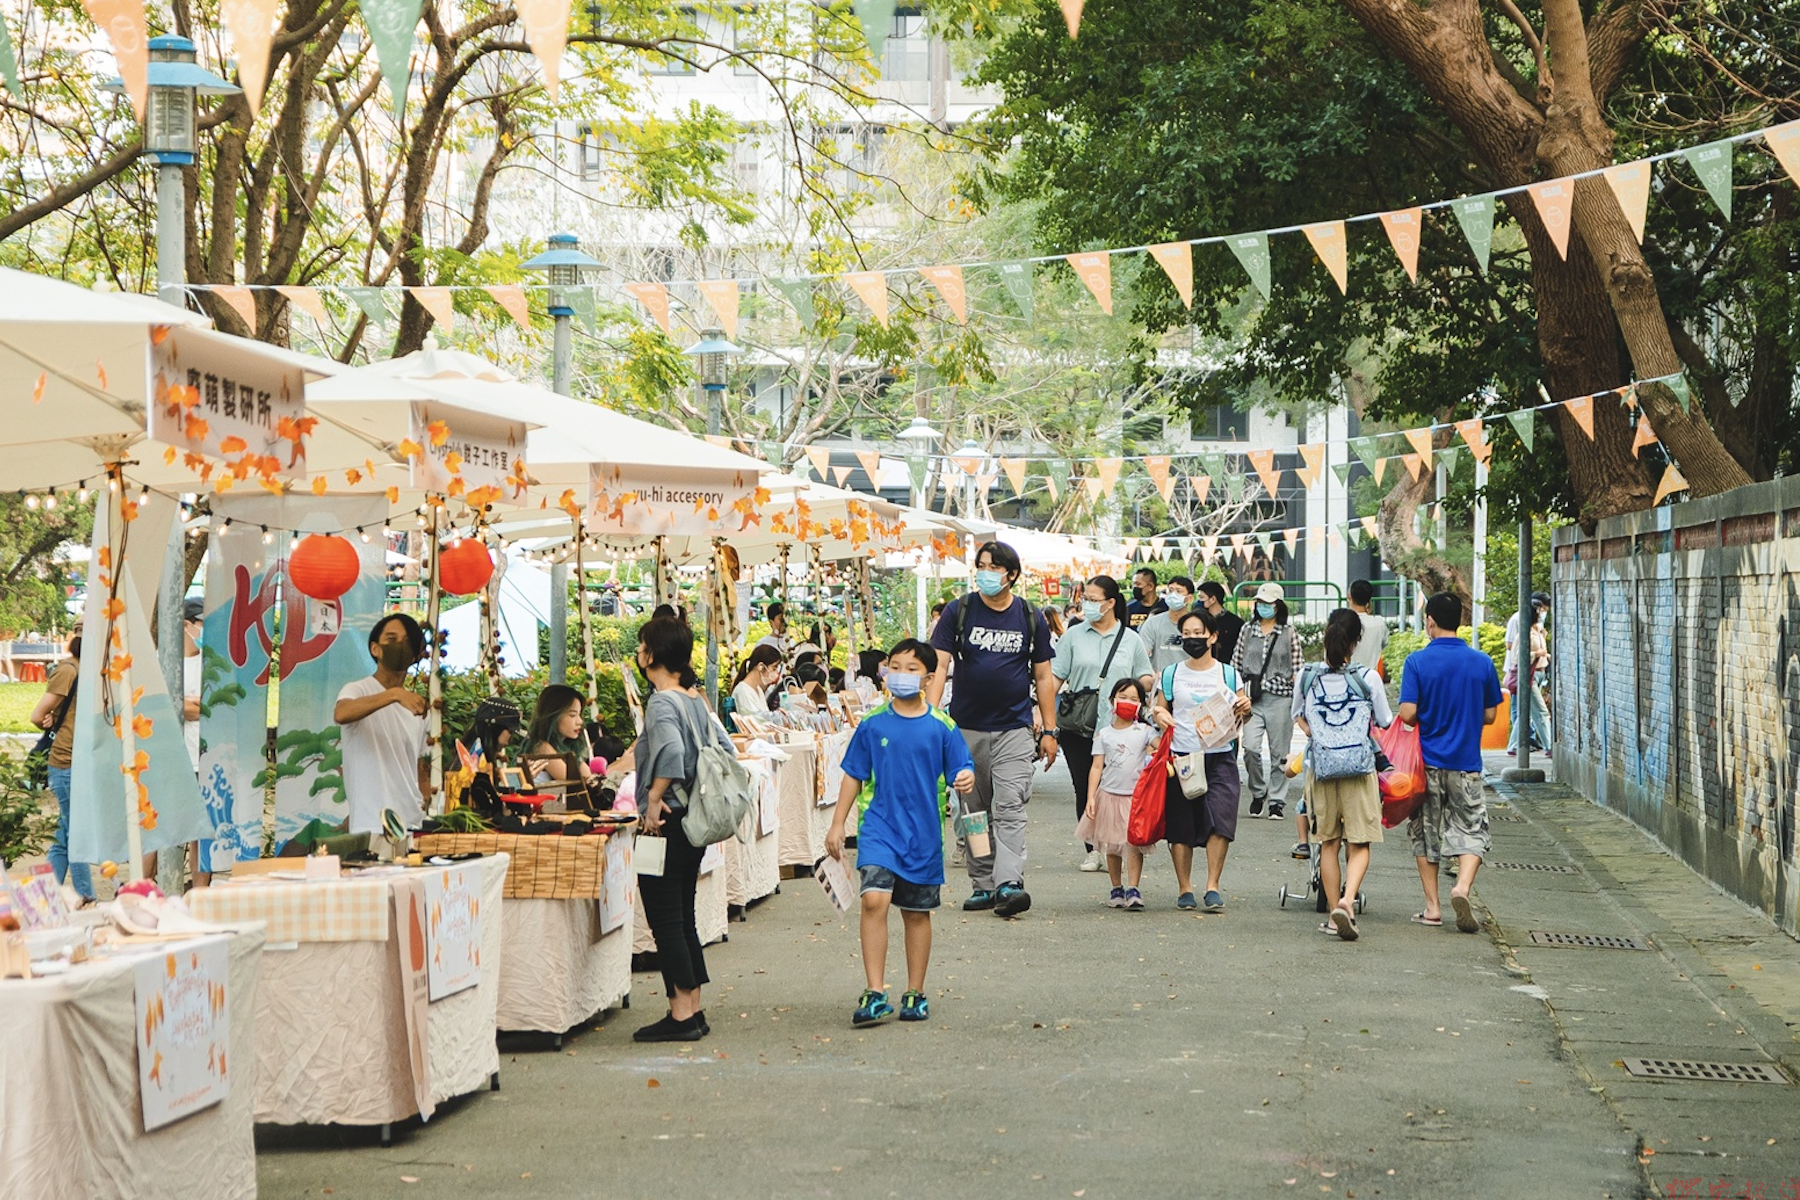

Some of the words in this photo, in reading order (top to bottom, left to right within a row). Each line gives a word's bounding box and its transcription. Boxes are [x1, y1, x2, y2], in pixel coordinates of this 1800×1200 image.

[632, 485, 663, 505] yu-hi
[666, 490, 724, 509] accessory
[969, 626, 1023, 649] RAMPS
